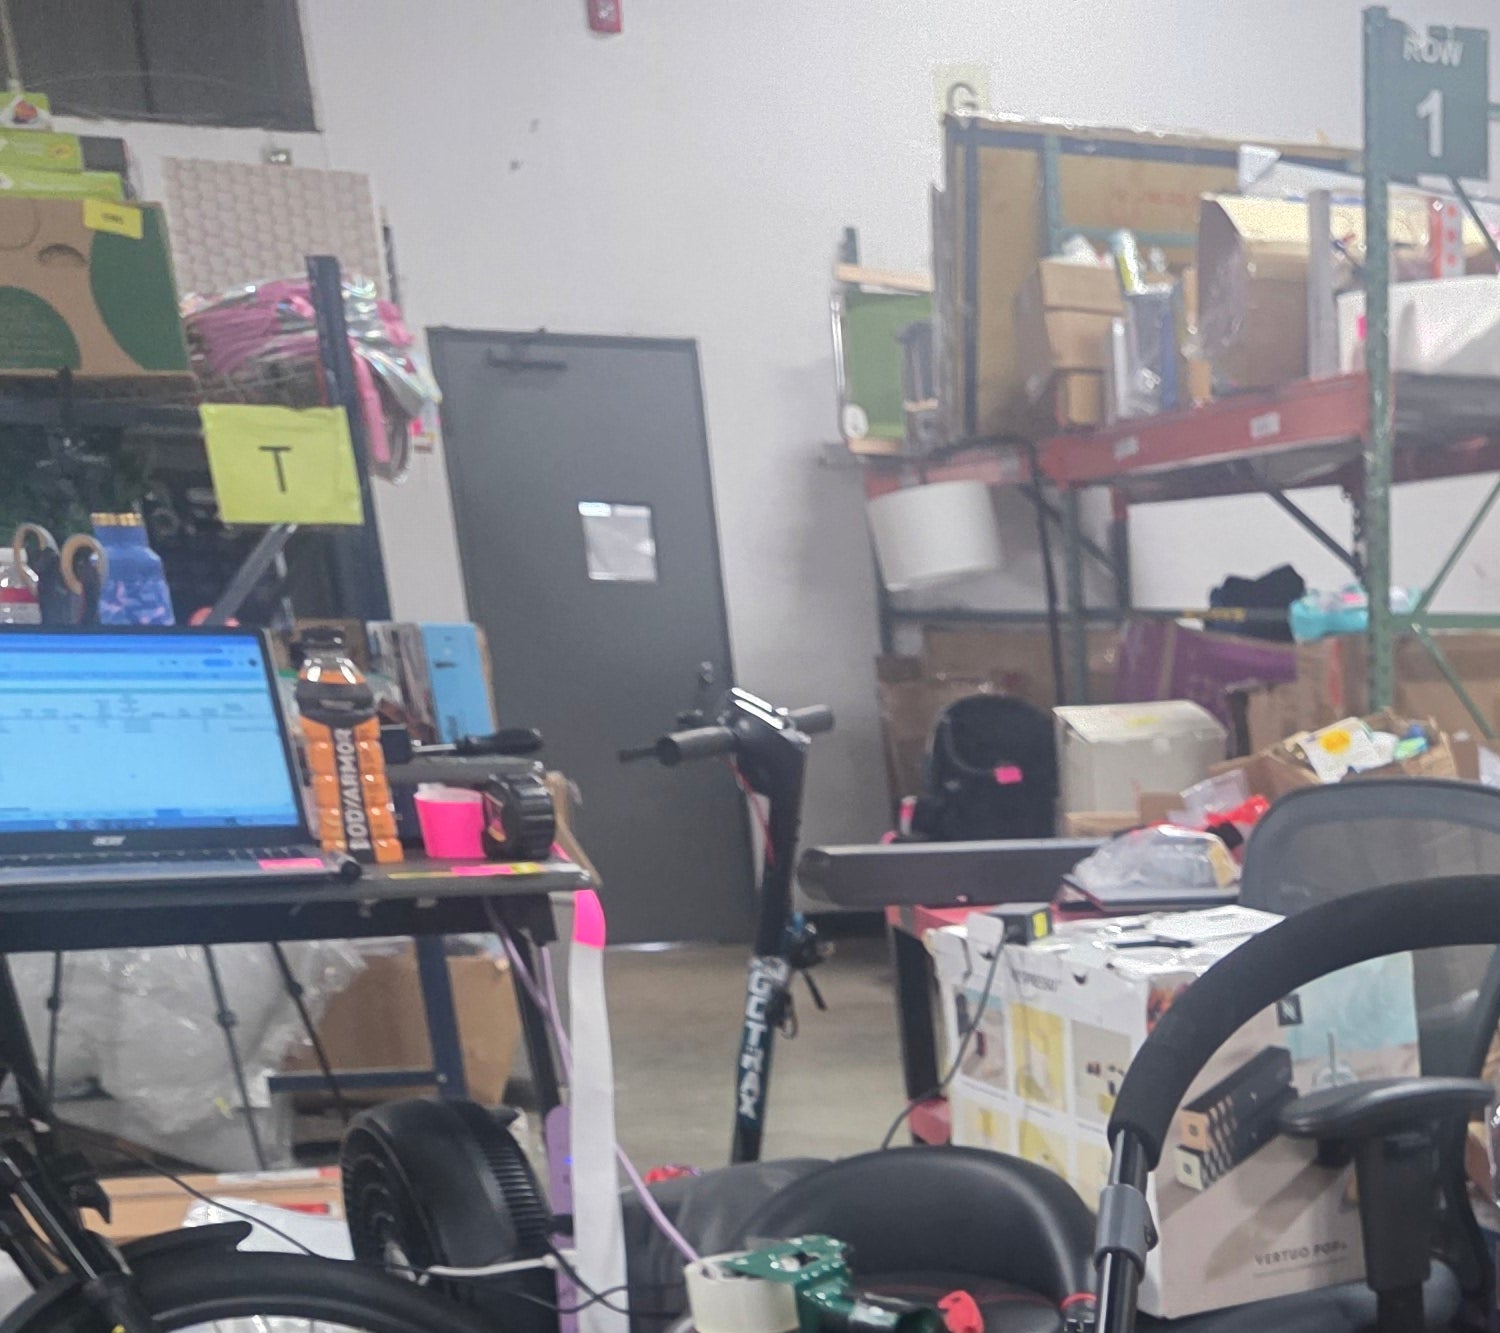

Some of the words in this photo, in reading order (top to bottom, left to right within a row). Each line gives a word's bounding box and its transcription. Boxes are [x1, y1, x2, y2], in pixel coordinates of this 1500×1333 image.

[1403, 37, 1464, 68] ROW
[1415, 88, 1445, 158] 1
[258, 445, 294, 493] T
[1254, 1246, 1310, 1265] VERTUO
